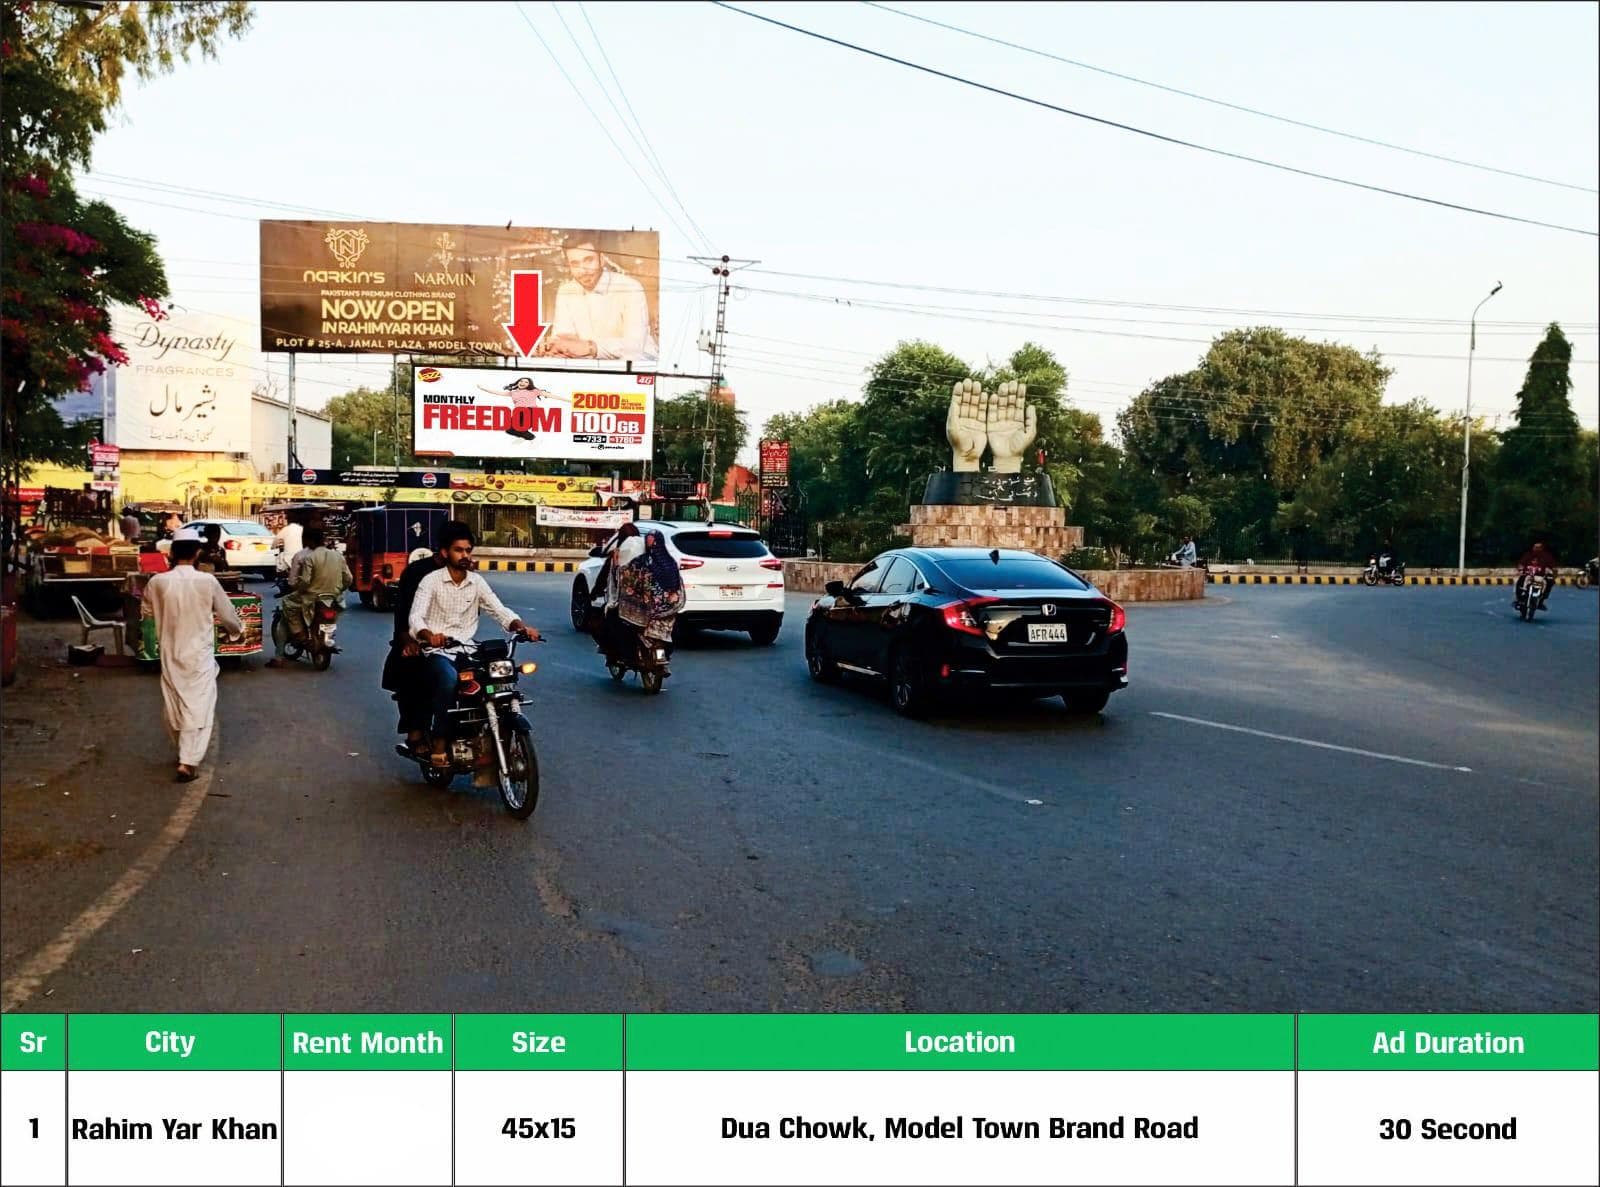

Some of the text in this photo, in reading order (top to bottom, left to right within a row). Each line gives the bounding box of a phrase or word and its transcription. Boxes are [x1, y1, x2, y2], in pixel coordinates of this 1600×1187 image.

[414, 272, 476, 287] NARMIN
[320, 290, 360, 298] PAKISTAN'S
[361, 290, 393, 298] PREMIUM
[321, 299, 454, 321] NOW OPEN
[321, 321, 454, 336] IN RAHIMYAR KHAN
[135, 322, 236, 361] Dynasty
[276, 337, 502, 351] PLOT # 25-A, JAMAL PLAZA, MODEL TOWN
[136, 364, 235, 377] FRAGRANCES
[638, 376, 652, 385] 4G
[423, 395, 475, 404] MONTHLY
[573, 393, 620, 409] 2000
[423, 404, 562, 433] FREEDOM
